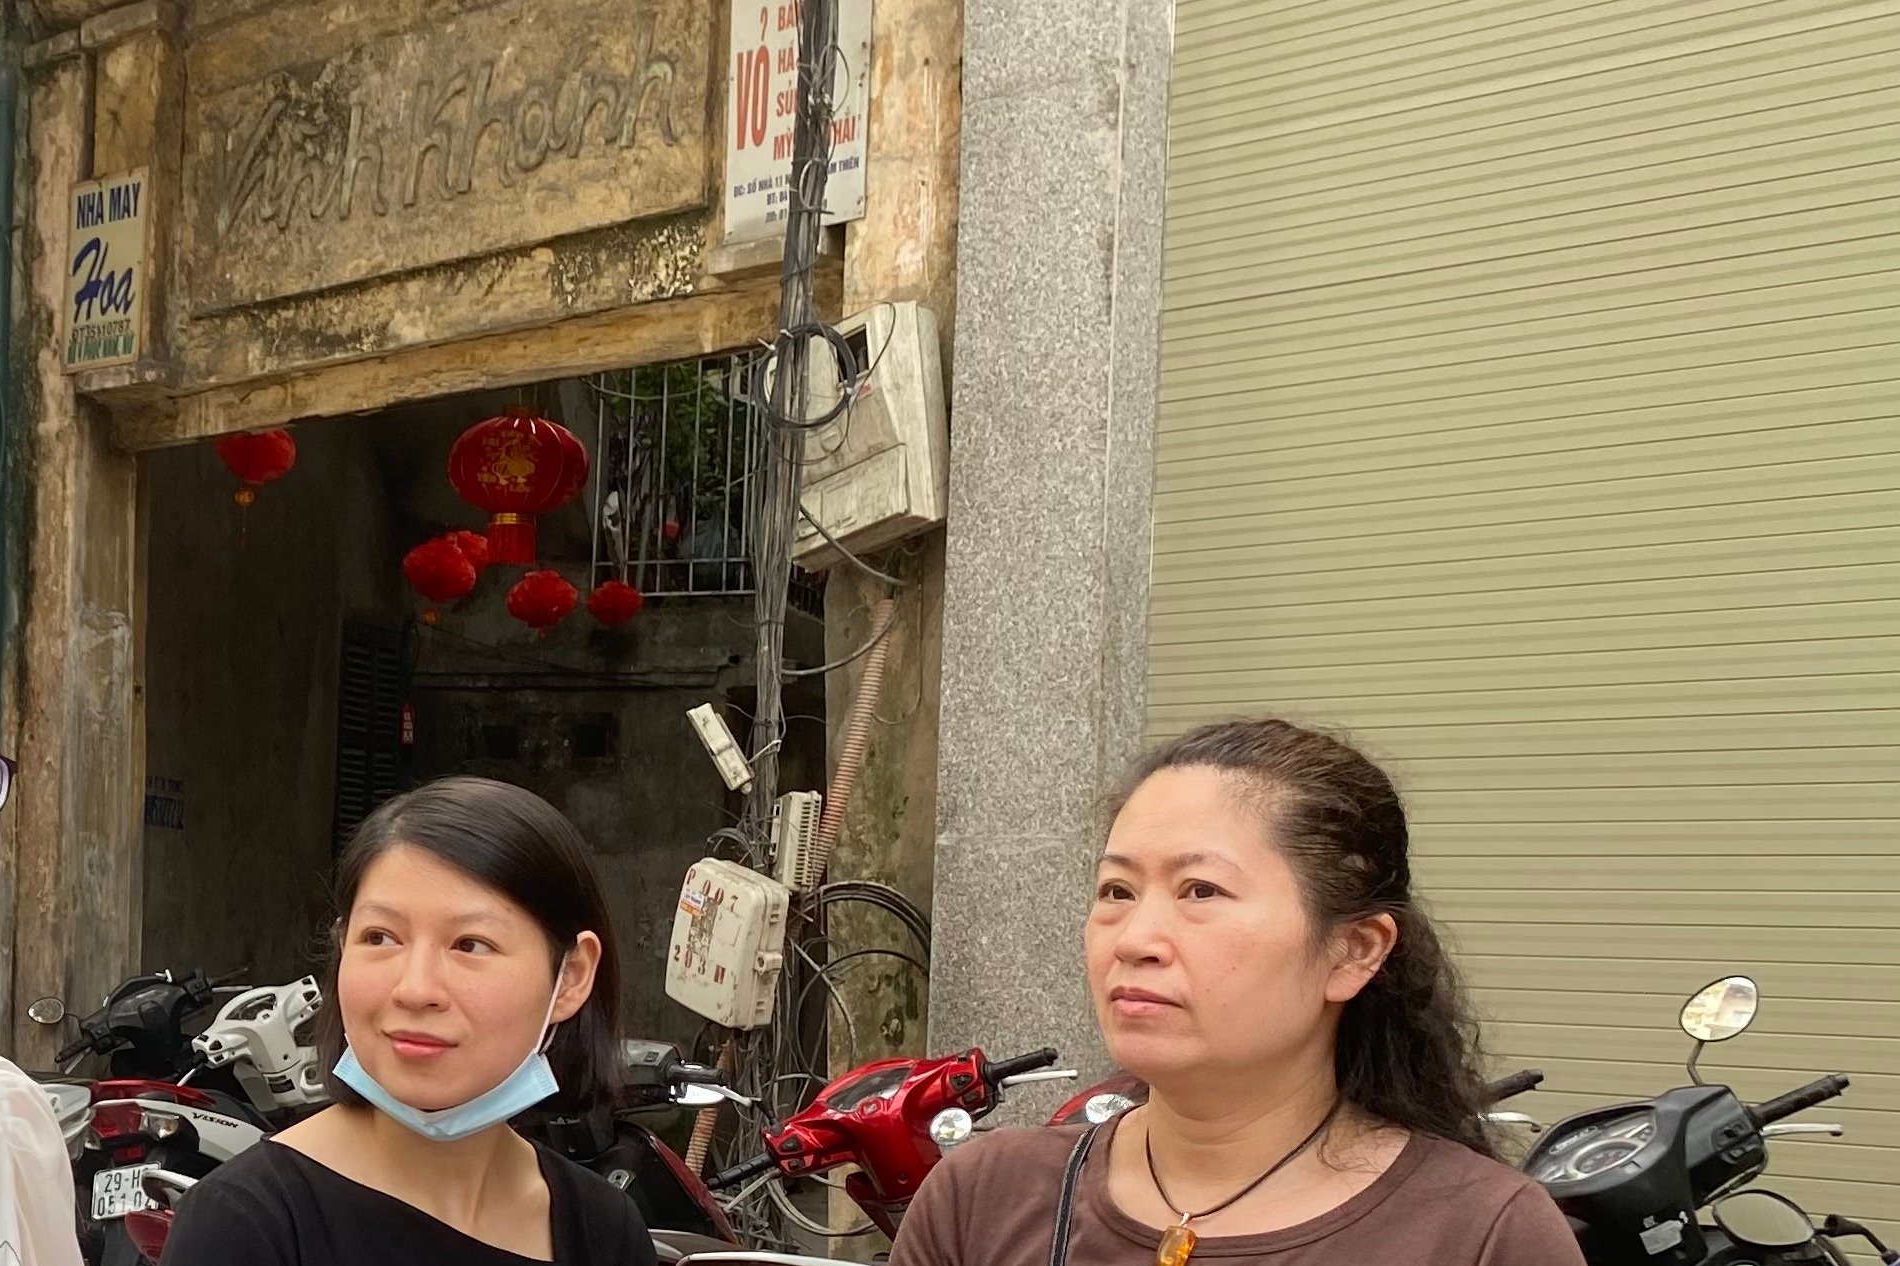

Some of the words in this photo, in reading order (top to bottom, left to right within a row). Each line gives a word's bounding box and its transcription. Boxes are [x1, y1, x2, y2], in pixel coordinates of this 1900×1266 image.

[108, 182, 141, 222] MAY
[72, 237, 135, 323] Hoa
[104, 1167, 149, 1193] 29-H
